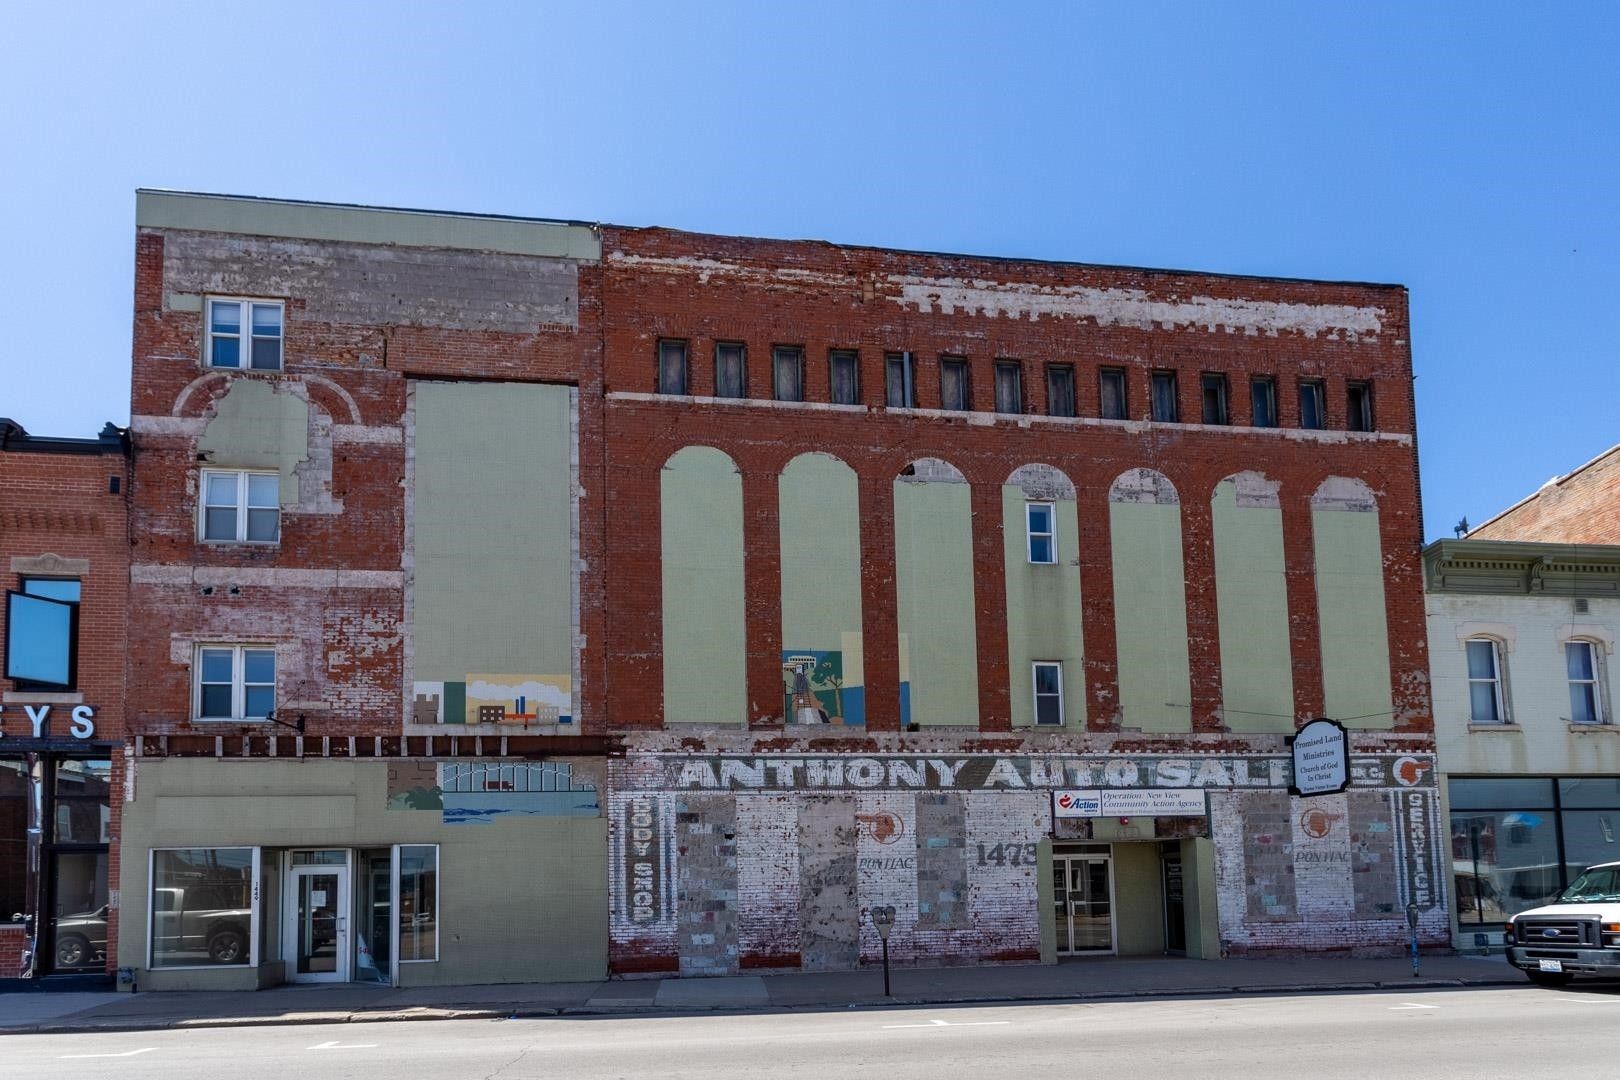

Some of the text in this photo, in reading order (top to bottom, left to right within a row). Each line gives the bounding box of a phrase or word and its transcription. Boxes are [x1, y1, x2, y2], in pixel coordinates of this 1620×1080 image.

[0, 705, 94, 738] YS
[1295, 733, 1342, 749] Promised Land
[1303, 750, 1334, 760] Ministries
[677, 759, 968, 788] ANTHONY
[983, 758, 1138, 788] AUTO
[1156, 759, 1290, 787] SALE
[1300, 764, 1320, 774] Church
[1321, 762, 1327, 770] of
[1070, 798, 1099, 809] Action
[1103, 800, 1149, 808] Community
[1176, 800, 1202, 808] Agency
[631, 799, 653, 856] BODY
[1409, 793, 1430, 906] SERVICE
[859, 858, 913, 870] PONTIAC
[1295, 851, 1350, 863] PONTIAC
[633, 862, 654, 921] SHOP
